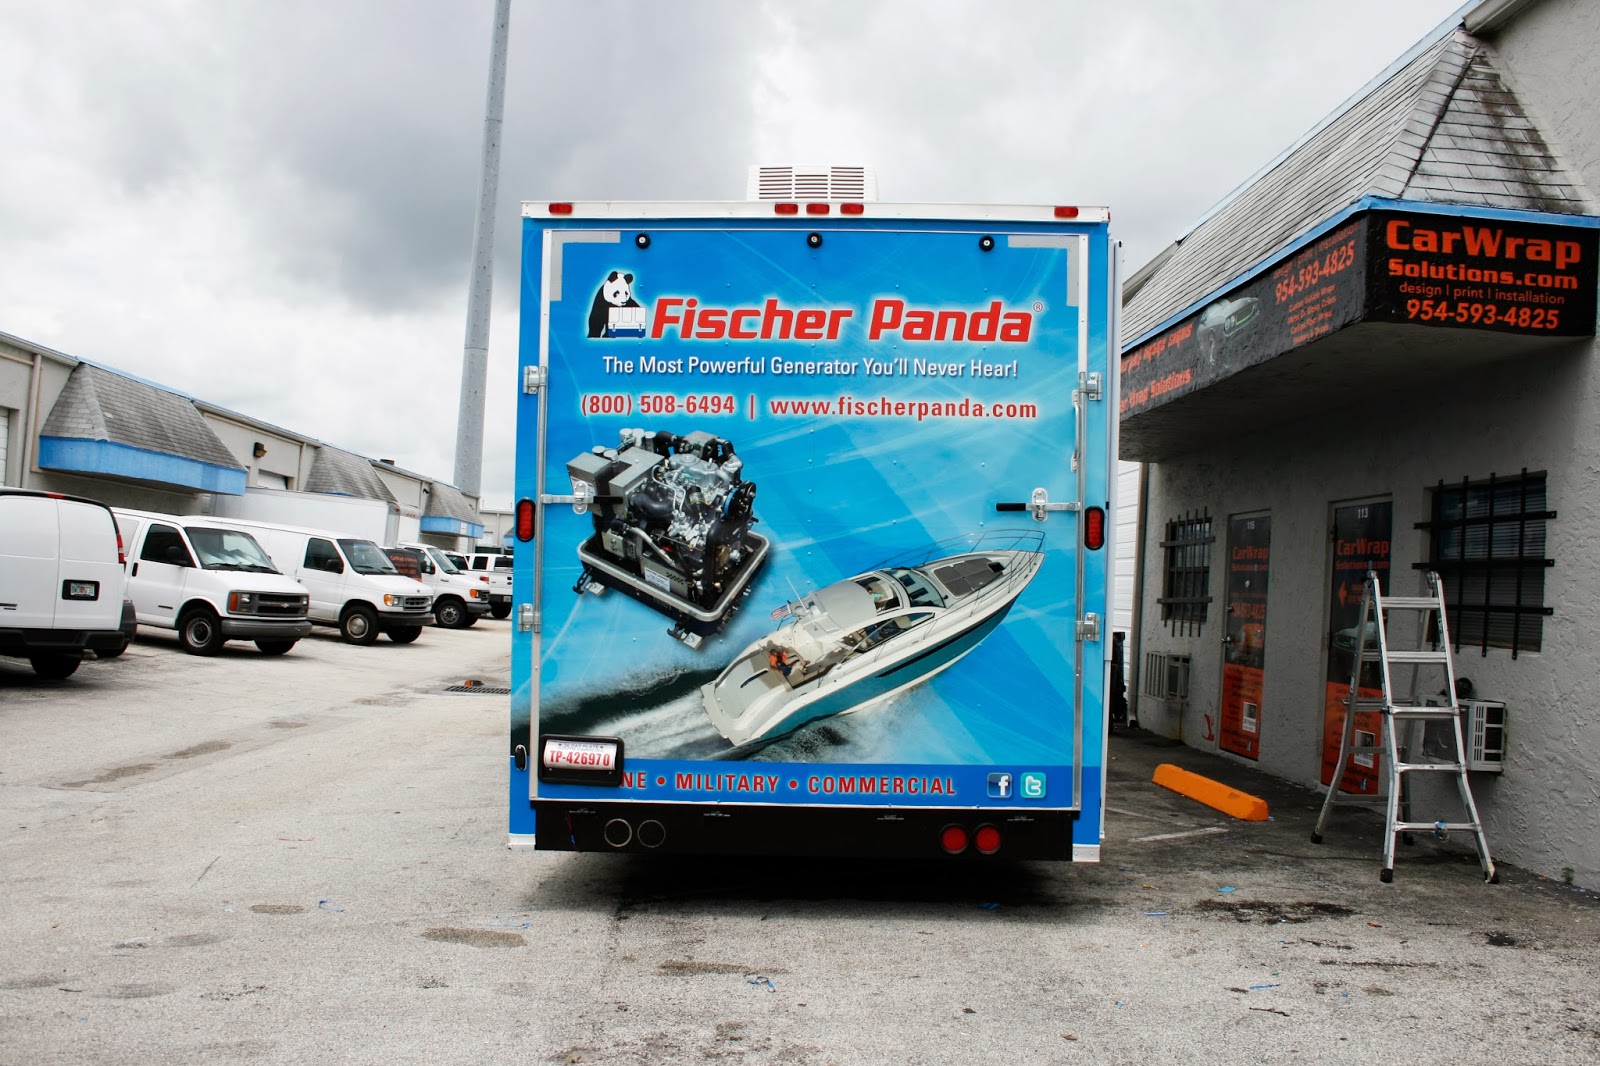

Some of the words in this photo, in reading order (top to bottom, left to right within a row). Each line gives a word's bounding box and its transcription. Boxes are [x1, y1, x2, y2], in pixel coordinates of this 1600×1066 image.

[1386, 220, 1582, 270] CarWrap
[1275, 240, 1356, 304] 954-593-4825
[1388, 258, 1579, 289] Solutions.com
[1399, 281, 1442, 298] design
[1453, 287, 1484, 300] print
[1495, 289, 1565, 304] installation
[651, 299, 853, 340] Fischer
[869, 300, 1034, 342] Panda
[1406, 299, 1560, 330] 954-593-4825
[603, 356, 633, 374] The
[640, 356, 682, 375] Most
[688, 357, 764, 376] Powerful
[770, 358, 857, 376] Generator
[862, 359, 908, 376] You'll
[914, 360, 963, 378] Never
[970, 360, 1018, 378] Hear!
[581, 394, 632, 415] (800)
[639, 395, 735, 415] 508-6494
[770, 397, 1038, 420] www.fischerpanda.com
[1357, 508, 1369, 519] 113
[1232, 545, 1269, 561] CarWrap
[1336, 537, 1390, 558] CarWrap
[550, 751, 611, 767] TP-426970
[621, 772, 648, 789] NE
[675, 773, 779, 794] MILITARY
[808, 777, 957, 796] COMMERCIAL
